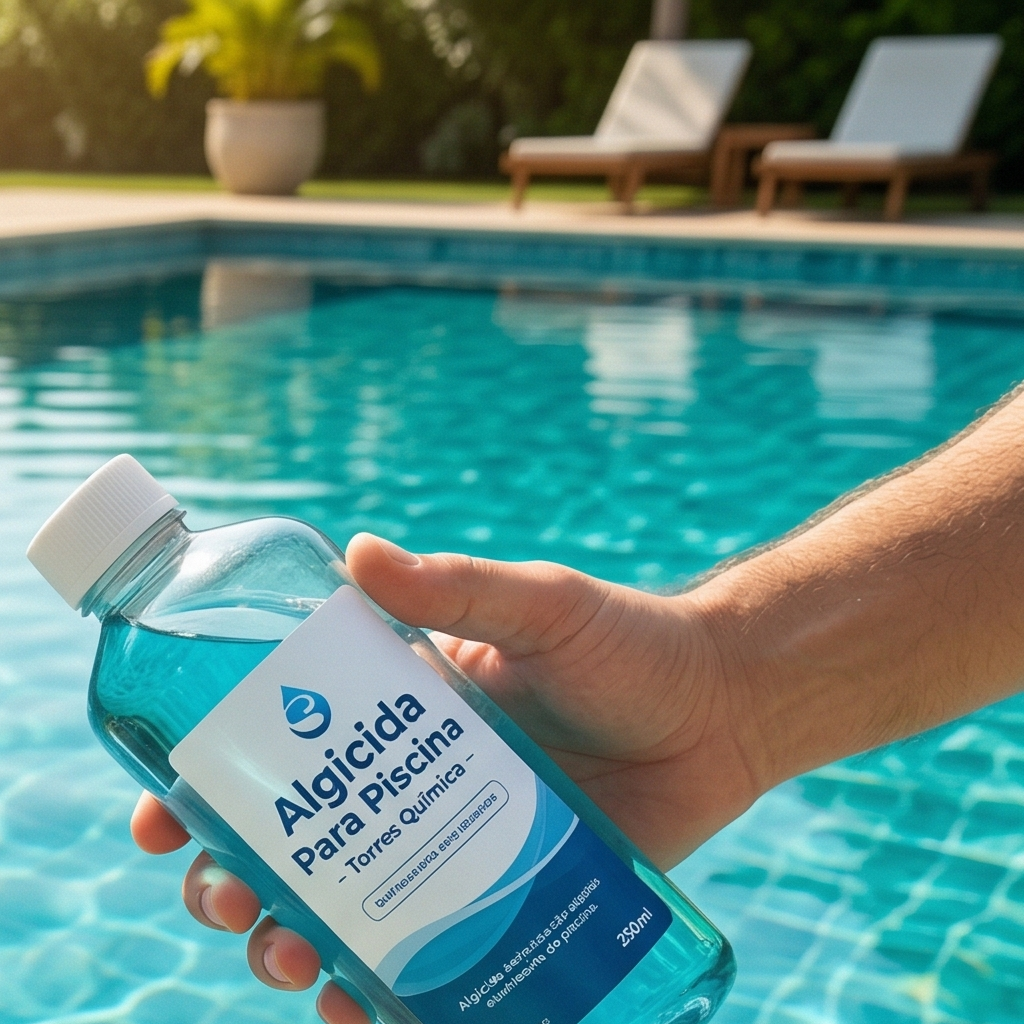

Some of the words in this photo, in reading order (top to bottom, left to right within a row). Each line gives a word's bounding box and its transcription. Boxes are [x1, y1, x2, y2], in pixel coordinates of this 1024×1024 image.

[274, 693, 427, 838] Algicida
[290, 812, 366, 877] Para
[357, 718, 465, 815] Piscina
[344, 824, 402, 874] Torres
[616, 906, 653, 948] 250ml
